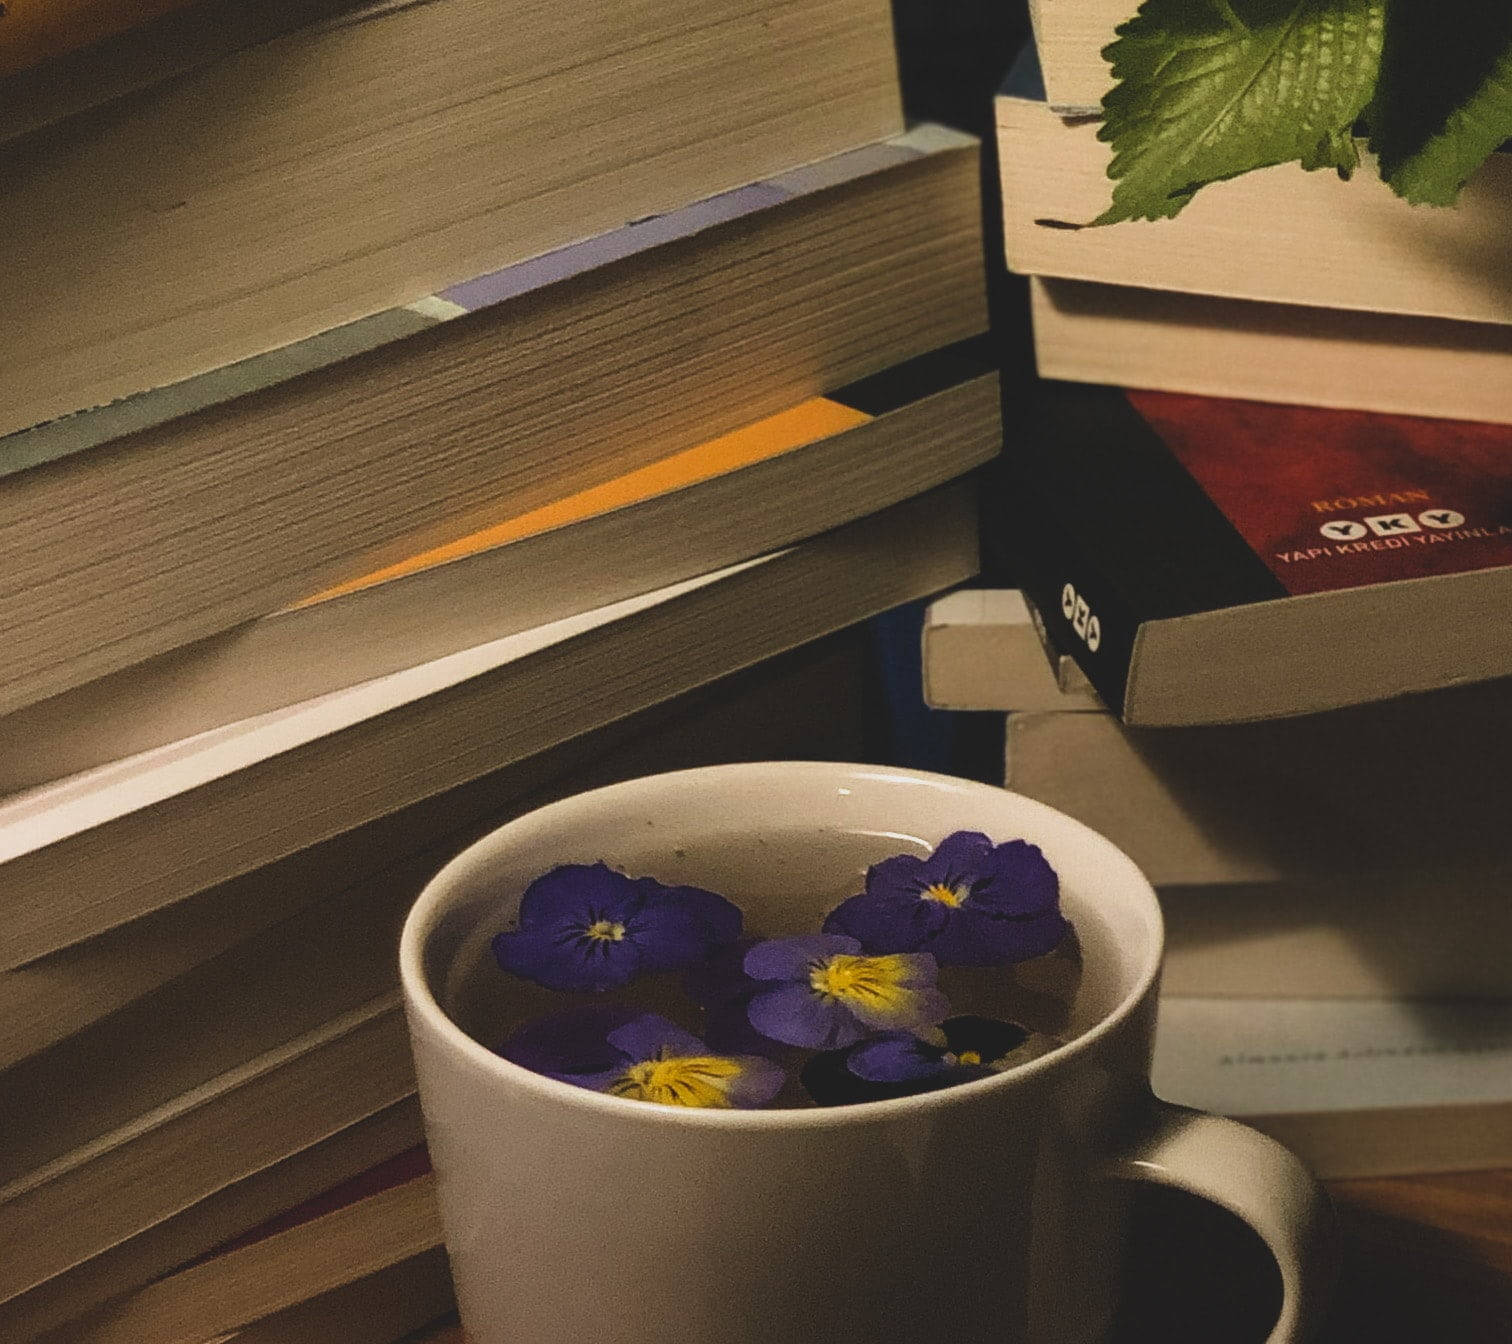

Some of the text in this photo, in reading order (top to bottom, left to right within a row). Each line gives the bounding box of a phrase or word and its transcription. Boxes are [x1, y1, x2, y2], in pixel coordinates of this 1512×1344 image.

[1310, 489, 1433, 513] ROMAN
[1322, 510, 1463, 539] YKY
[1274, 547, 1332, 564] YAPI
